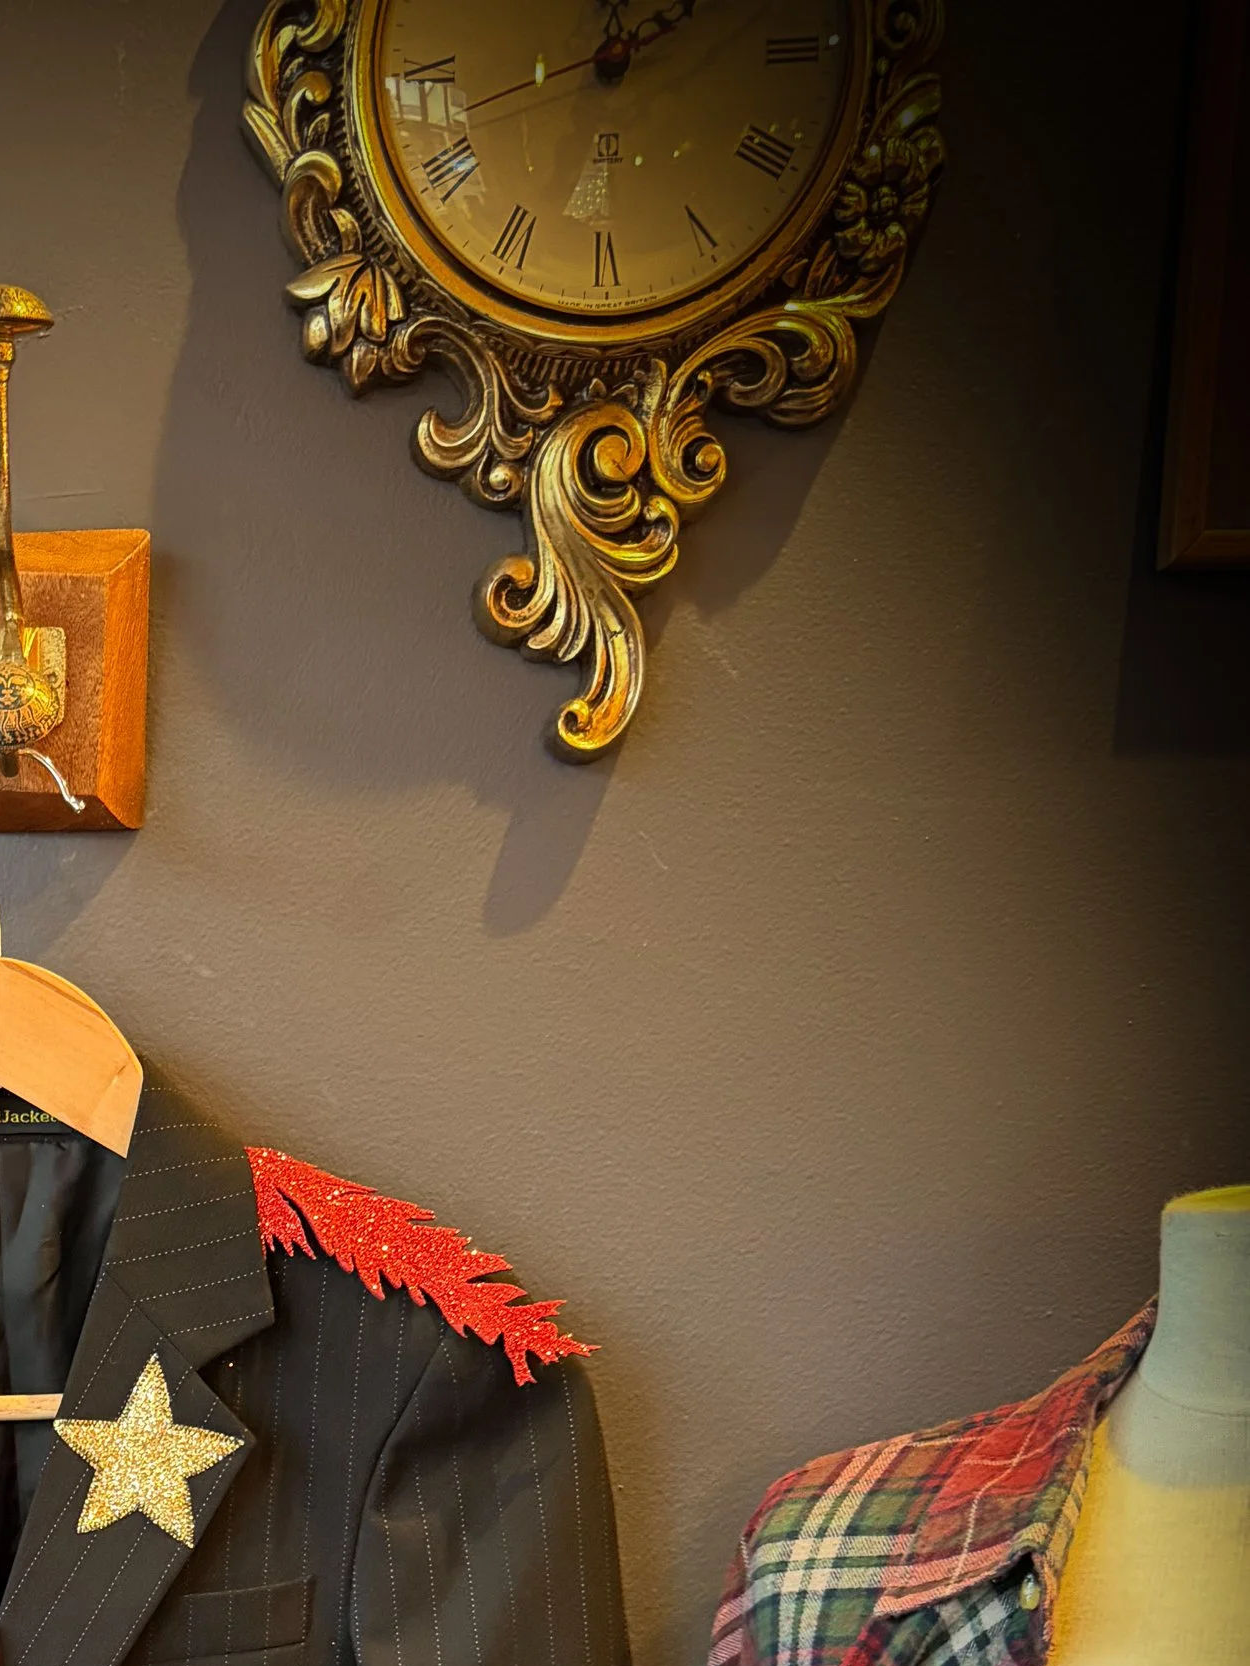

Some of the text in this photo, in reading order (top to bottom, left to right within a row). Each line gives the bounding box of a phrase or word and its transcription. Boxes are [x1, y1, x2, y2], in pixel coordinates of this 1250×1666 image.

[765, 36, 820, 65] III
[490, 204, 537, 269] VII
[684, 204, 718, 257] V
[592, 231, 623, 288] VI
